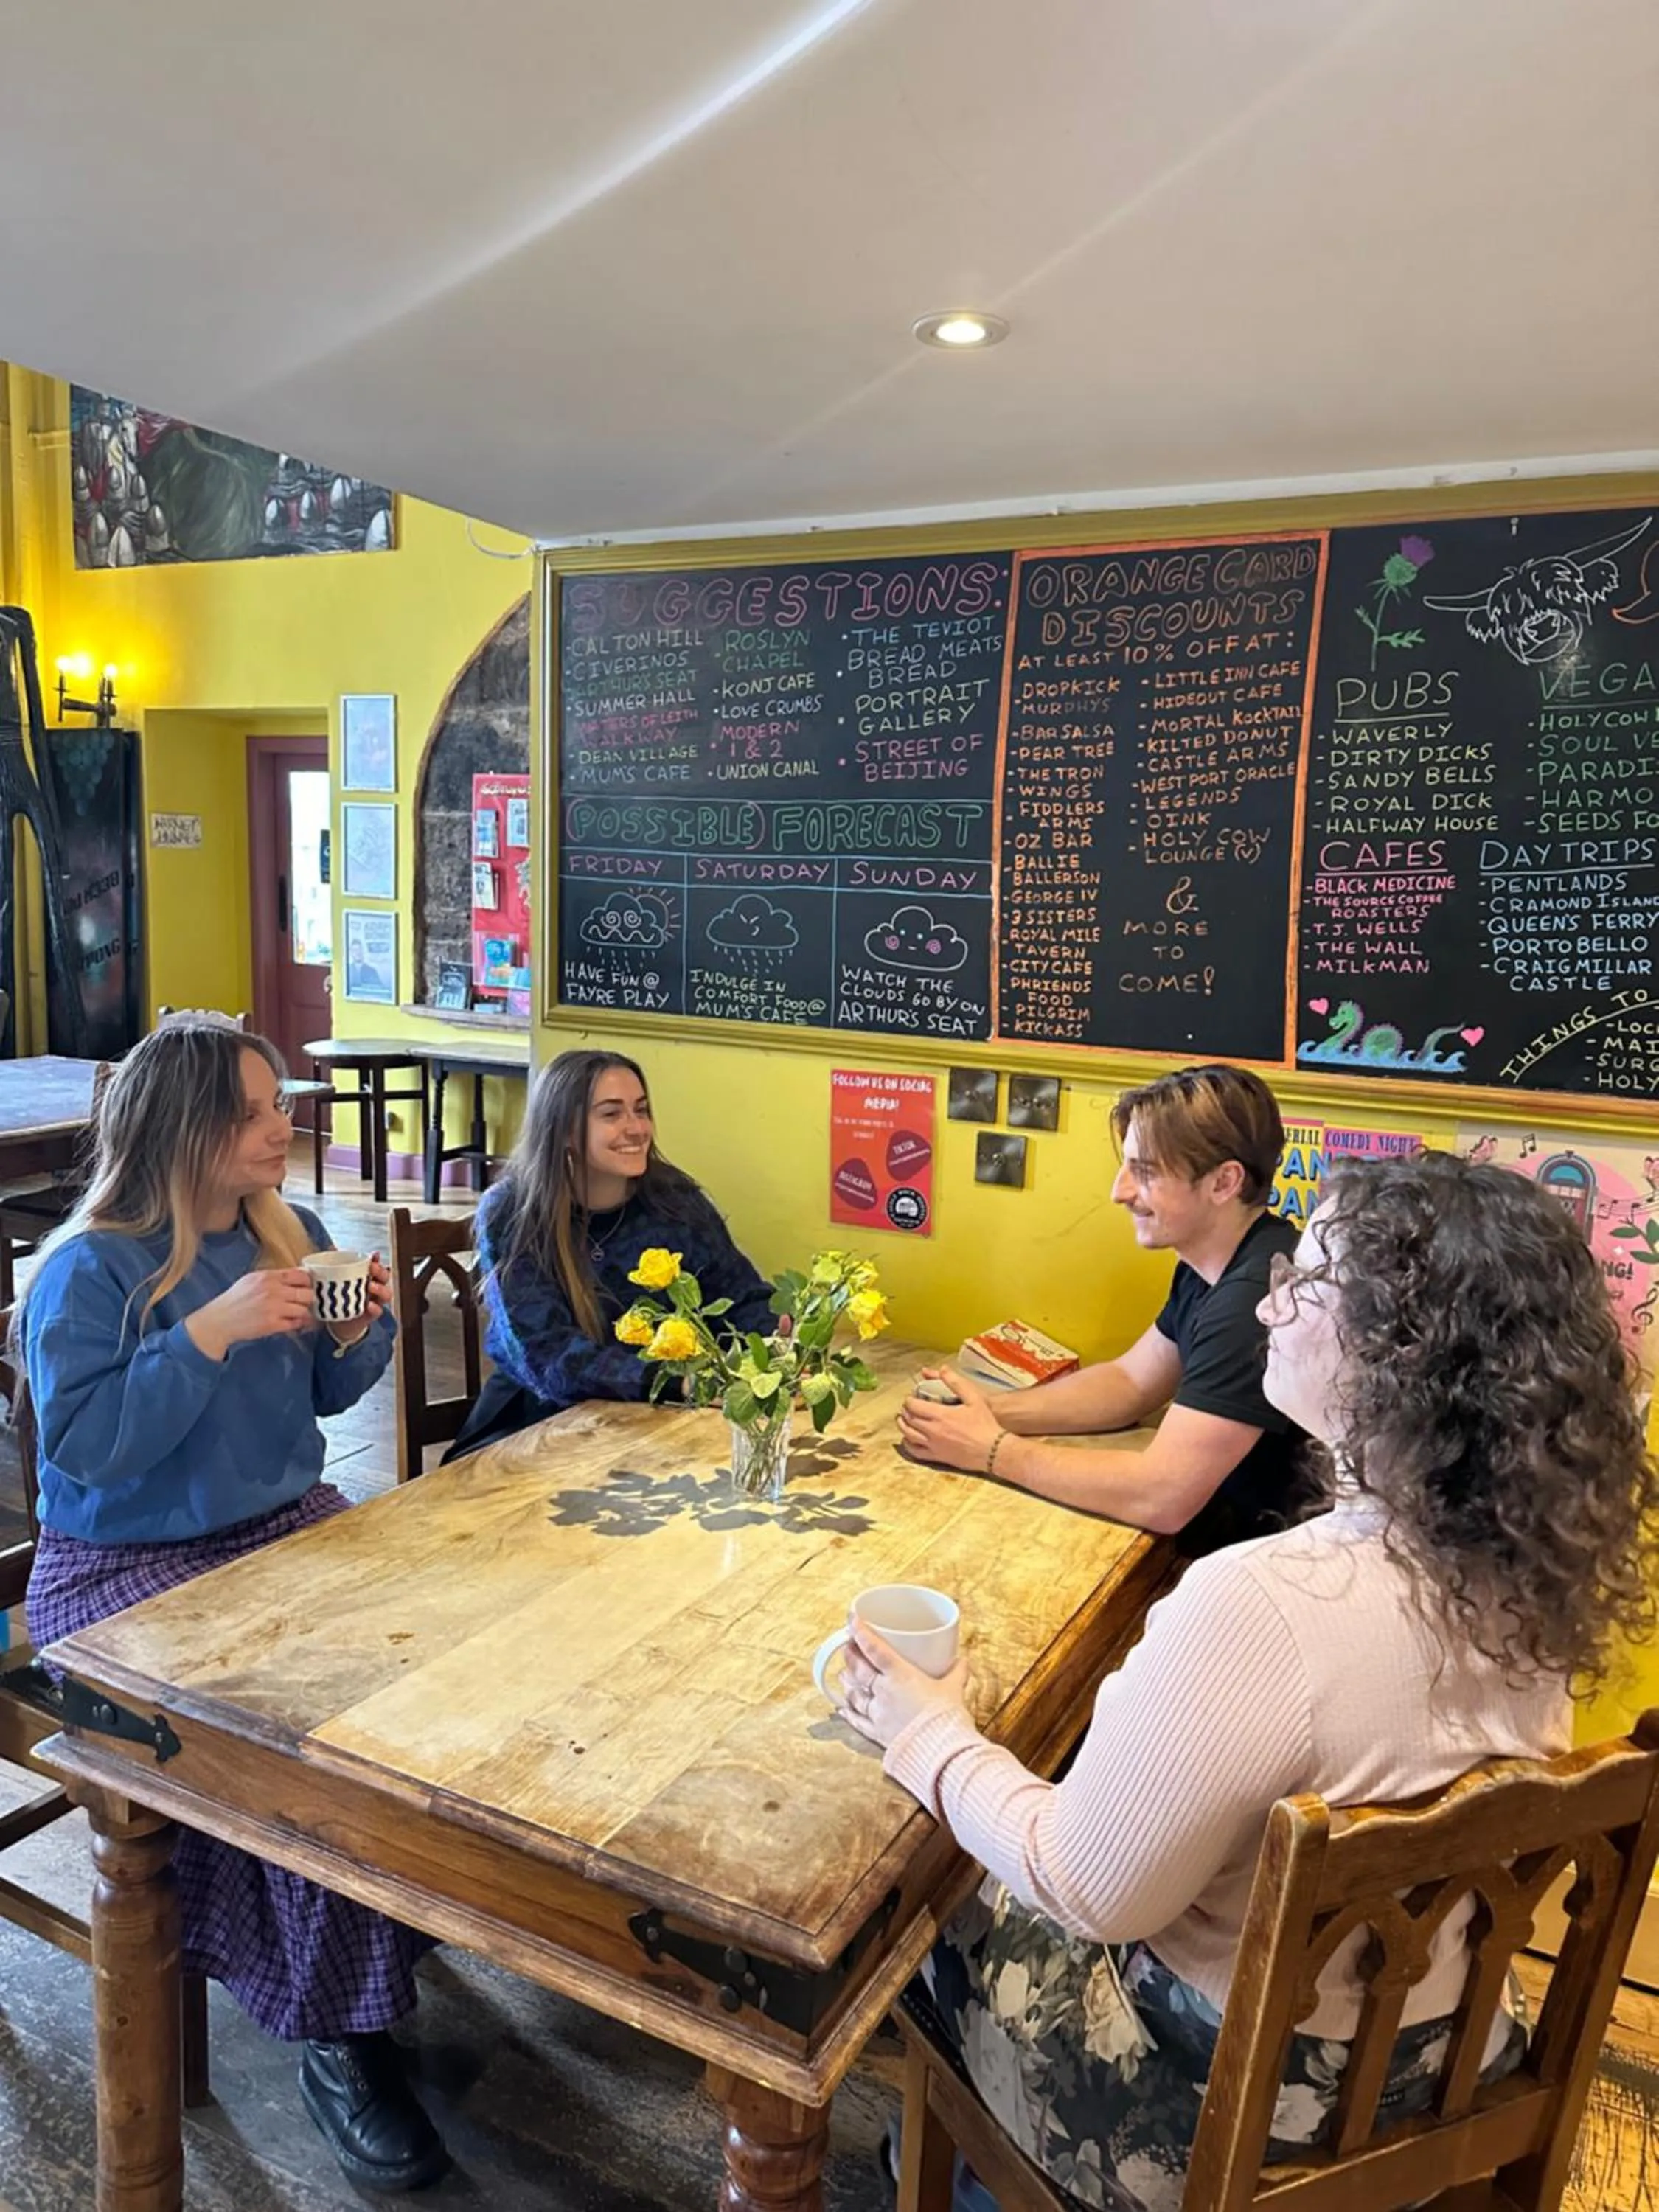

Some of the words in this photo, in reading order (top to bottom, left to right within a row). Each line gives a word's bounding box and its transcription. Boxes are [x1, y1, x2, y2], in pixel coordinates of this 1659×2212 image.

[1026, 554, 1211, 608] ORANGE
[1213, 548, 1317, 594] CARD
[1041, 589, 1306, 648] DISCOUNTS
[657, 630, 704, 647] HILL
[724, 629, 810, 653] ROSLYN
[851, 626, 902, 647] THE
[912, 615, 995, 639] TEVIOT
[722, 650, 804, 673] CHAPEL
[848, 644, 926, 671] BREAD
[938, 635, 1004, 661] MEATS
[1018, 654, 1046, 670] AT
[1054, 651, 1115, 667] LEAST
[1124, 643, 1175, 665] 10%
[1186, 635, 1239, 658] OFF
[656, 669, 698, 689] SEAT
[777, 672, 815, 691] CAFE
[868, 661, 957, 689] BREAD
[1155, 668, 1221, 689] LITTLE
[1257, 660, 1301, 678] CAFE
[855, 678, 990, 714] PORTRAIT
[1022, 676, 1121, 699] DROPKICK
[1153, 690, 1228, 710] HIDEOUT
[1232, 684, 1284, 703] CAFE
[1335, 670, 1460, 718] PUBS
[574, 694, 647, 717] SUMMER
[653, 689, 696, 707] HALL
[721, 703, 760, 719] LOVE
[765, 694, 824, 717] CRUMBS
[720, 720, 800, 740] MODERN
[858, 703, 975, 736] GALLERY
[1151, 713, 1225, 734] MORTAL
[1539, 712, 1602, 732] HOLY
[1604, 709, 1649, 728] COW
[1020, 725, 1057, 741] BAR
[1060, 723, 1116, 739] SALSA
[1147, 734, 1217, 754] KILTED
[1223, 726, 1294, 745] DONUT
[1332, 722, 1453, 745] WAVERLY
[578, 750, 622, 764] DEAN
[629, 745, 698, 762] VILLAGE
[745, 739, 762, 759] &
[769, 739, 784, 758] 2
[855, 737, 942, 763] STREET
[951, 734, 984, 752] OF
[1019, 746, 1065, 761] PEAR
[1071, 741, 1115, 759] TREE
[1330, 748, 1411, 768] DIRTY
[1418, 742, 1494, 763] DICKS
[1537, 734, 1619, 757] SOUL
[1147, 751, 1219, 772] CASTLE
[1226, 741, 1290, 763] ARMS
[644, 765, 690, 782] CAFE
[717, 762, 769, 780] UNION
[773, 759, 821, 778] CANAL
[864, 759, 970, 782] BEIJING
[1017, 767, 1051, 781] THE
[1054, 764, 1105, 780] TRON
[1234, 762, 1297, 782] ORACLE
[1328, 770, 1415, 790] SANDY
[1425, 764, 1497, 785] BELLS
[1018, 783, 1093, 799] WINGS
[1144, 786, 1242, 811] LEGENDS
[1019, 801, 1105, 818] FIDDLERS
[1329, 795, 1416, 813] ROYAL
[1432, 791, 1493, 811] DICK
[771, 804, 984, 852] FORECAST
[1039, 817, 1093, 830] ARMS
[1147, 812, 1212, 829] OINK
[1326, 815, 1427, 835] HALFWAY
[1434, 815, 1500, 833] HOUSE
[1537, 809, 1624, 834] SEEDS
[1015, 832, 1043, 849] OZ
[1051, 831, 1093, 849] BAR
[1143, 830, 1208, 847] HOLY
[1217, 827, 1271, 845] COW
[1144, 846, 1225, 864] LOUNGE
[1318, 839, 1447, 872] CAFES
[1479, 839, 1551, 871] DAY
[1559, 837, 1657, 863] TRIPS
[568, 854, 663, 877] FRIDAY
[695, 858, 830, 883] SATURDAY
[849, 861, 977, 889] SUNDAY
[1012, 871, 1101, 886] BALLERSON
[1315, 877, 1368, 894] BLACK
[1373, 874, 1458, 893] MEDICINE
[1490, 872, 1629, 894] PENTLANDS
[1011, 889, 1074, 904] GEORGE
[1080, 888, 1098, 902] IV
[1166, 875, 1200, 914] &
[1312, 896, 1340, 908] THE
[1344, 894, 1394, 907] SOURCE
[1489, 896, 1593, 914] CRAMOND
[1012, 909, 1022, 925] 3
[1026, 907, 1097, 925] SISTERS
[1331, 905, 1431, 919] ROASTERS
[1592, 911, 1659, 931] FERRY
[1009, 928, 1057, 942] ROYAL
[1061, 926, 1101, 943] MILE
[1123, 921, 1210, 936] MORE
[1356, 919, 1423, 936] WELLS
[1015, 943, 1086, 959] TAVERN
[1152, 945, 1184, 959] TO
[1315, 941, 1357, 955] THE
[1364, 940, 1424, 956] WALL
[565, 960, 606, 983] HAVE
[611, 973, 641, 987] FUN
[1009, 959, 1049, 974] CITY
[1051, 961, 1093, 975] CAFE
[1315, 959, 1430, 974] MILKMAN
[689, 969, 758, 990] INDULGE
[763, 980, 787, 992] IN
[841, 964, 908, 988] WATCH
[915, 978, 954, 993] THE
[1010, 977, 1092, 993] PHRIENDS
[1119, 965, 1215, 995] COME!
[1509, 975, 1613, 992] CASTLE
[566, 982, 616, 1005] FAYRE
[624, 990, 670, 1008] PLAY
[694, 986, 768, 1006] COMFORT
[840, 981, 905, 1002] CLOUDS
[936, 996, 958, 1012] BY
[960, 1001, 985, 1015] ON
[1028, 992, 1073, 1006] FOOD
[759, 1006, 808, 1025] CAFE
[1015, 1003, 1091, 1022] PILGRIM
[927, 1013, 977, 1036] SEAT
[1014, 1019, 1084, 1038] KICKASS
[1499, 1006, 1596, 1078] THINGS
[1610, 989, 1649, 1008] TO
[1326, 1130, 1371, 1150] COMEDY
